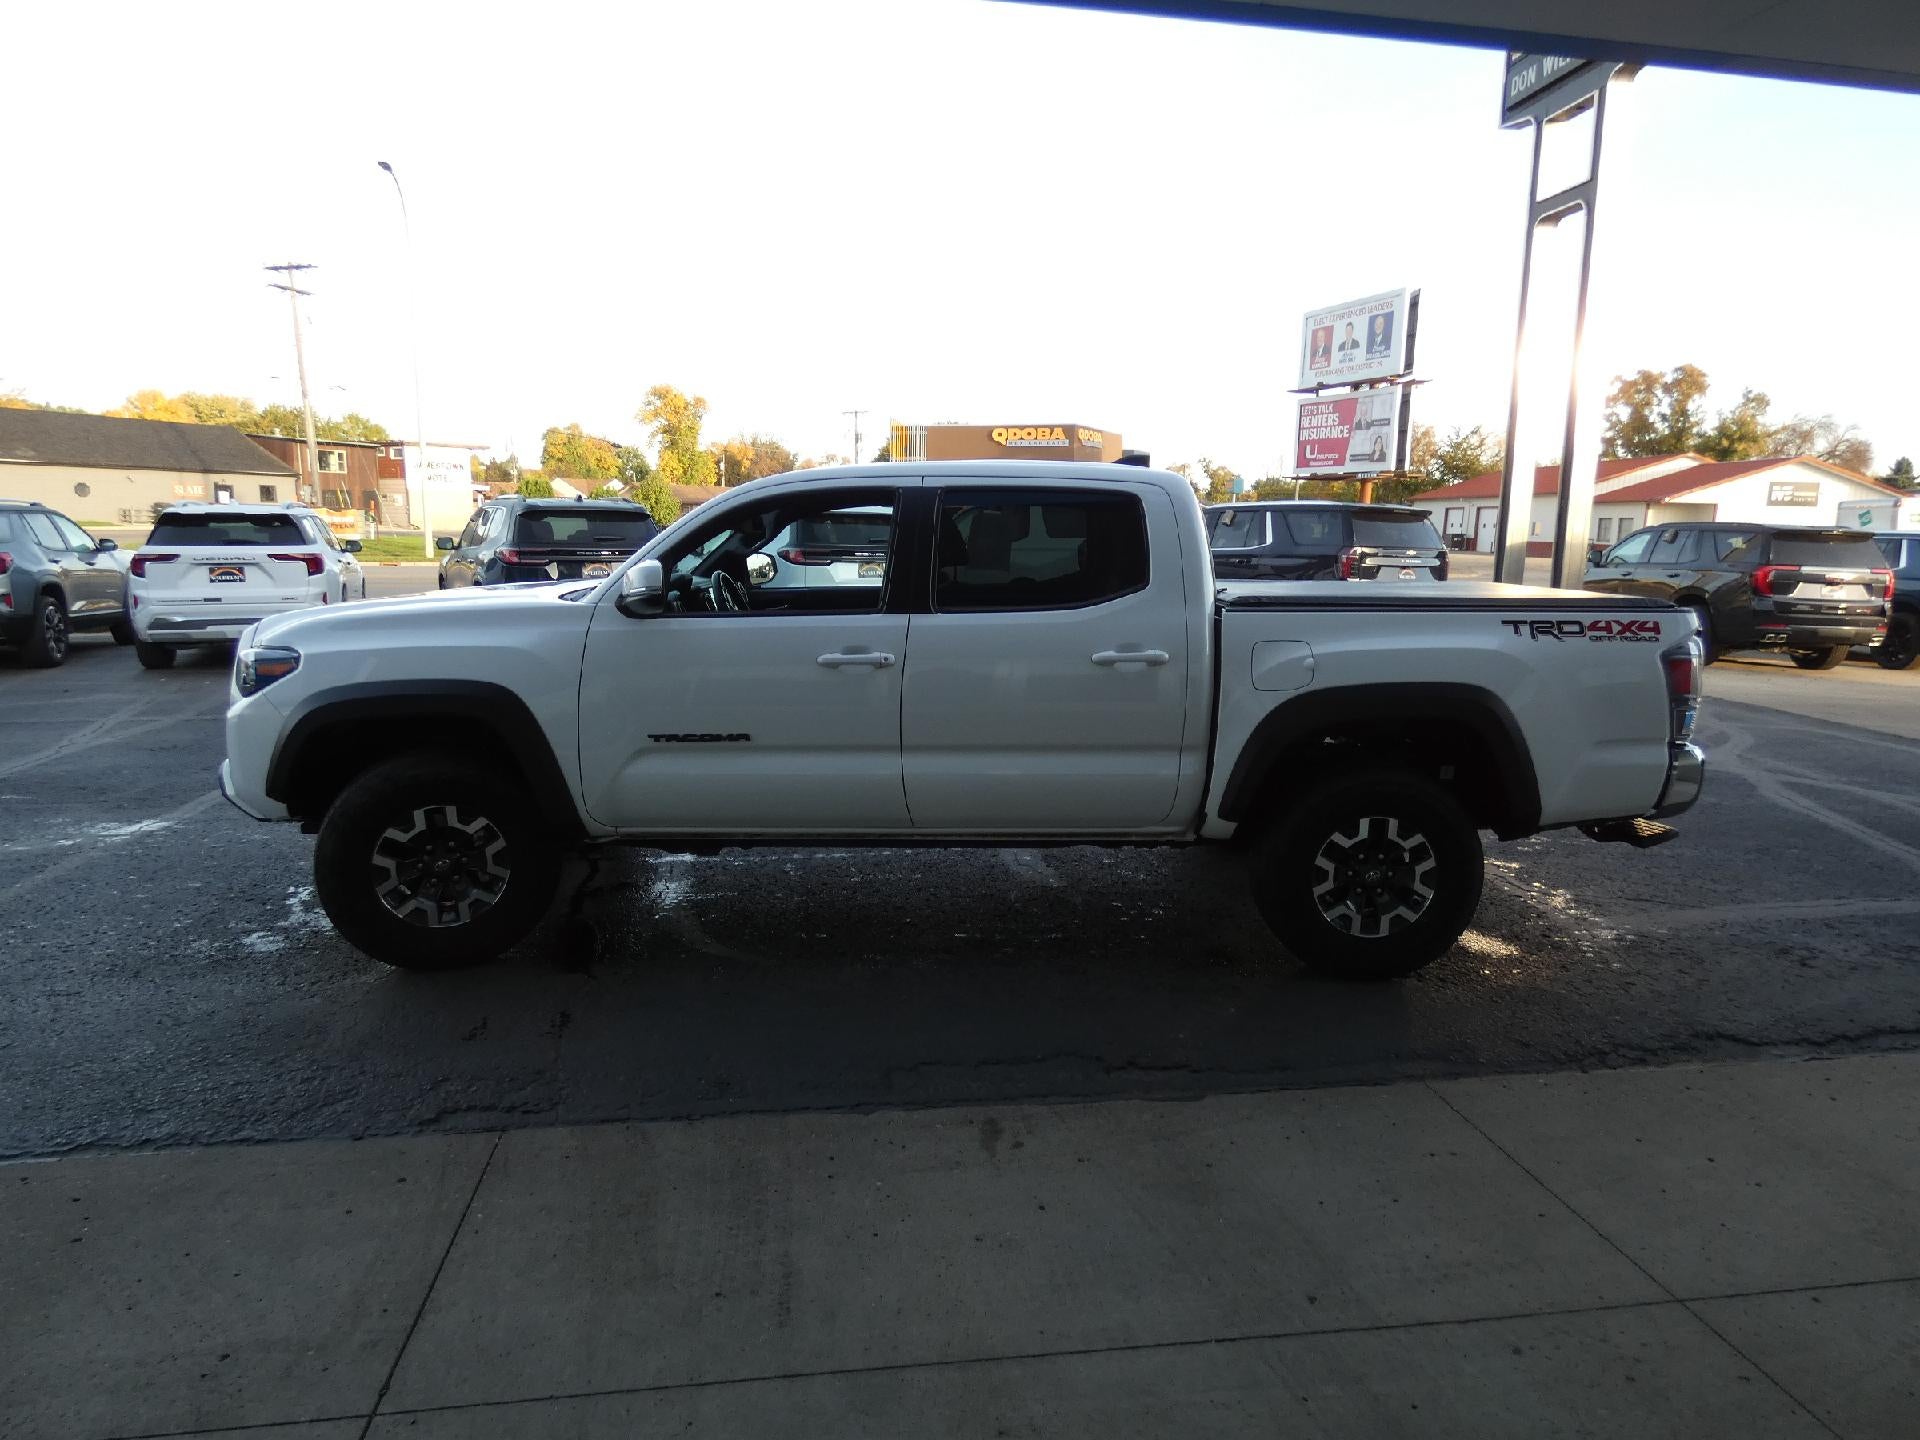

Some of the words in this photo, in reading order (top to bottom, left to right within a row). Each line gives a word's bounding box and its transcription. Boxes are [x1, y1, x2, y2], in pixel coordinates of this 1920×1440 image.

[1510, 65, 1537, 97] DON
[1542, 55, 1572, 77] WIL
[1367, 300, 1394, 315] LEADERS
[1301, 404, 1317, 415] LET'S
[1318, 403, 1334, 414] TALK
[1301, 413, 1339, 427] RENTERS
[992, 427, 1066, 446] QDOBA
[1078, 428, 1102, 442] QDOBA
[1300, 425, 1350, 441] INSURANCE
[1501, 620, 1587, 642] TRD
[1587, 620, 1661, 636] 4X4
[1588, 635, 1618, 643] OFF
[1619, 635, 1660, 643] ROAD
[647, 733, 751, 743] TACOMA
